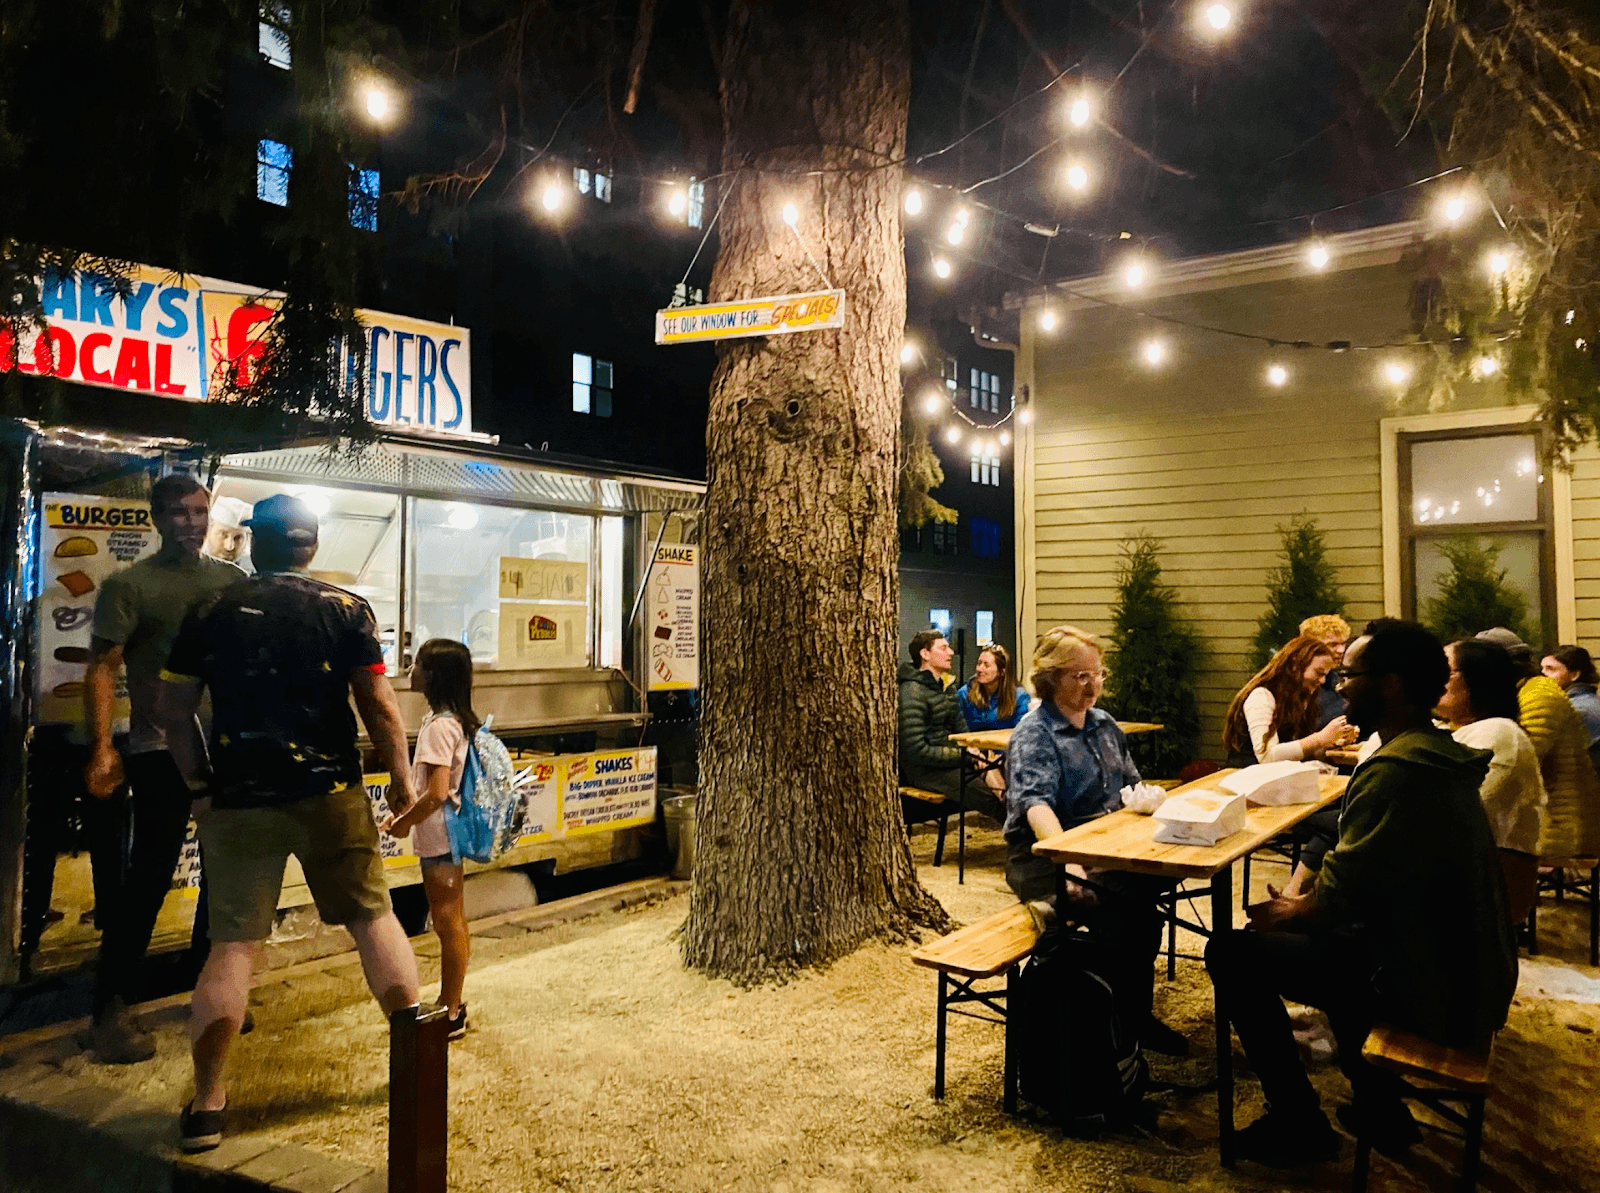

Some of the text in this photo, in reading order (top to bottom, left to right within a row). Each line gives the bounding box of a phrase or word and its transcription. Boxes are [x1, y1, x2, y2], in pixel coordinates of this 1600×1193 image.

[38, 262, 190, 339] ARY'S
[662, 318, 678, 336] SEE
[680, 316, 698, 334] OUR
[700, 312, 737, 331] WINDOW
[60, 505, 152, 527] BURGER
[657, 547, 694, 562] SHAKE
[595, 756, 633, 775] SHAKES
